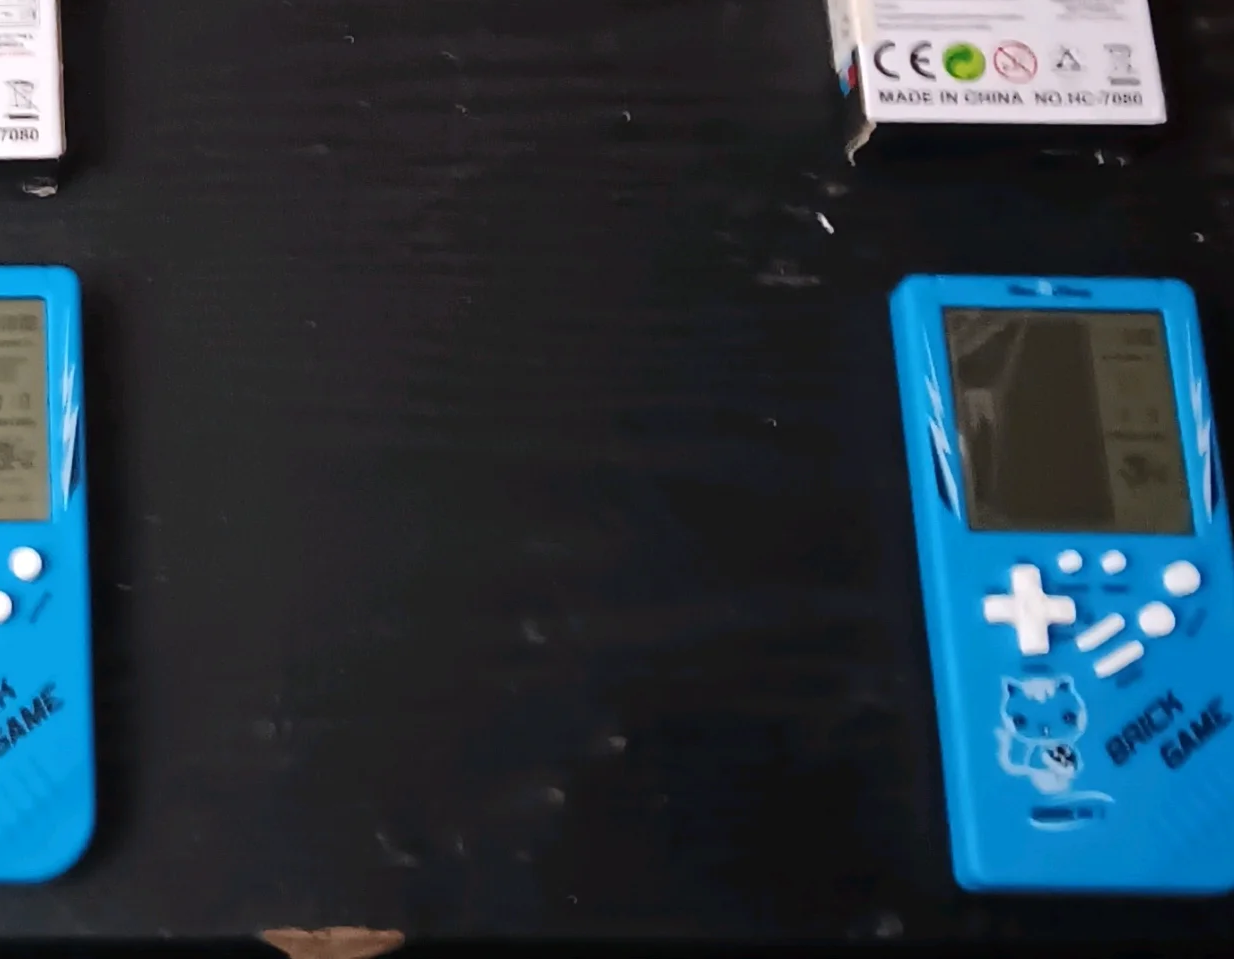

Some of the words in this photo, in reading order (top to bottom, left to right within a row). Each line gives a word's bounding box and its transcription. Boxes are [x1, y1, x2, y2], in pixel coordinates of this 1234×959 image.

[877, 90, 934, 104] MADE
[939, 90, 959, 104] IN
[963, 91, 1024, 105] CHINA
[1105, 689, 1184, 767] BRICK
[1159, 694, 1233, 770] GAME
